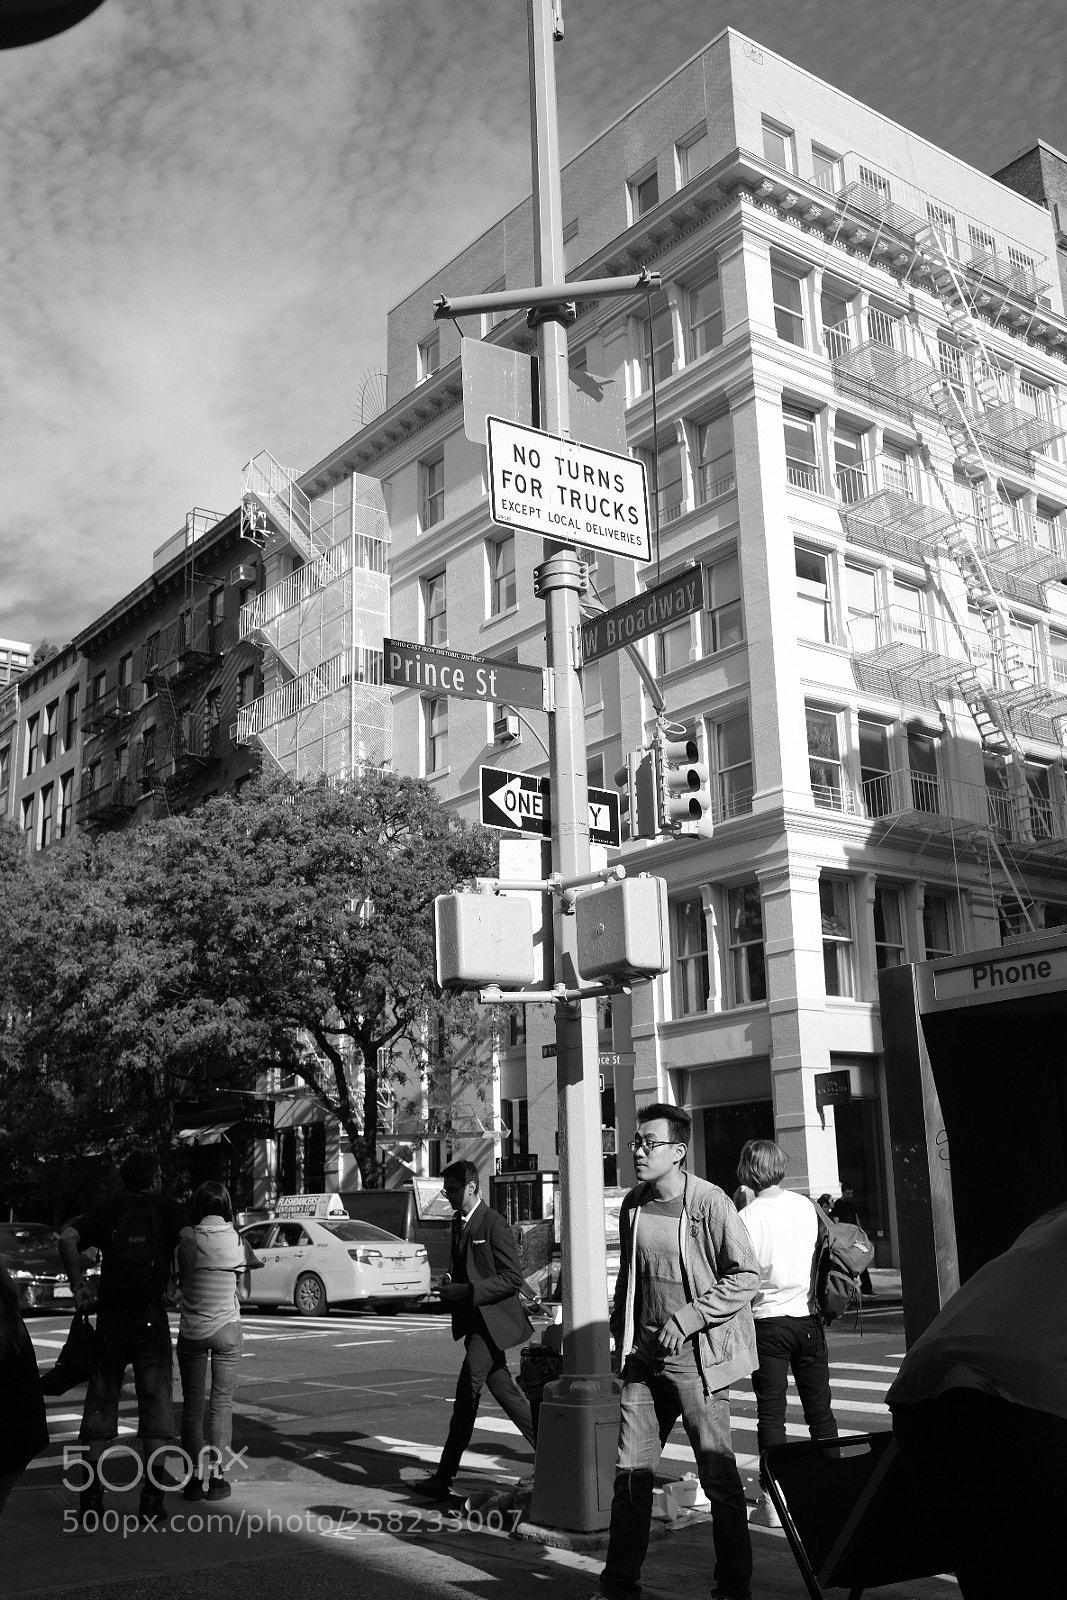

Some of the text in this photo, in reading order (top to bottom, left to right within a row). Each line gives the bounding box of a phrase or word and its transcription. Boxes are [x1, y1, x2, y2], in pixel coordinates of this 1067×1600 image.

[513, 443, 625, 493] NO TURNS
[502, 469, 640, 525] FOR TRUCKS
[501, 498, 542, 519] EXCEPT
[548, 511, 581, 530] LOCAL
[585, 522, 642, 546] DELIVERIES
[584, 580, 696, 657] W Broadway
[406, 643, 421, 652] CAST
[389, 651, 498, 698] Prince St
[504, 789, 543, 817] ONE
[972, 960, 1052, 990] Phone
